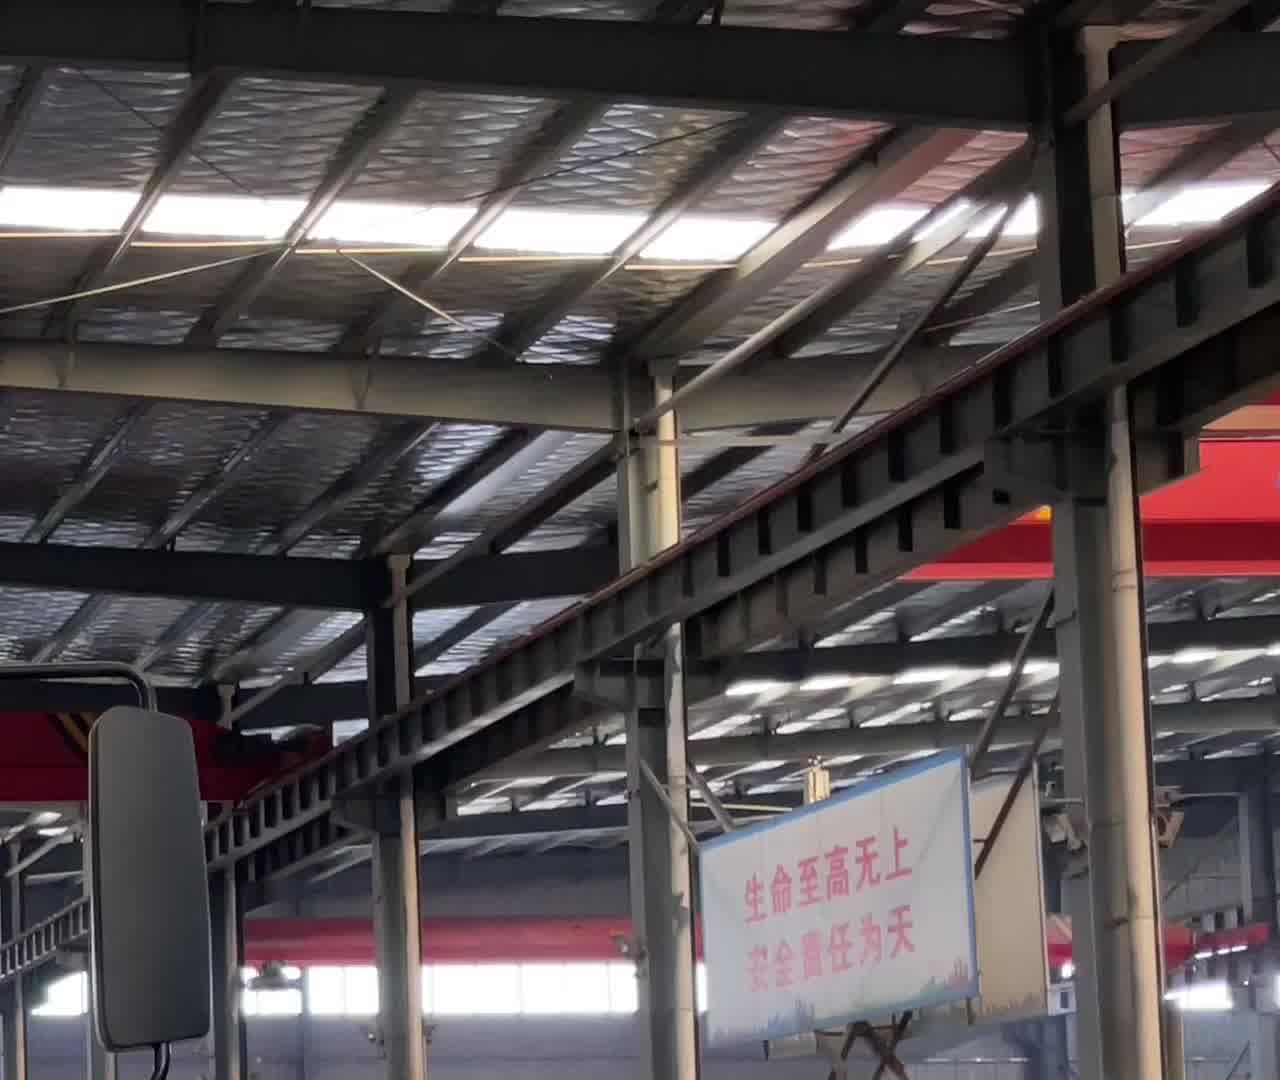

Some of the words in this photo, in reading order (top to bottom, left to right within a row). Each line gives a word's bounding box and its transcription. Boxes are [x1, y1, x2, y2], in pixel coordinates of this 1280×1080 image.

[744, 826, 913, 924] 生命至高无上
